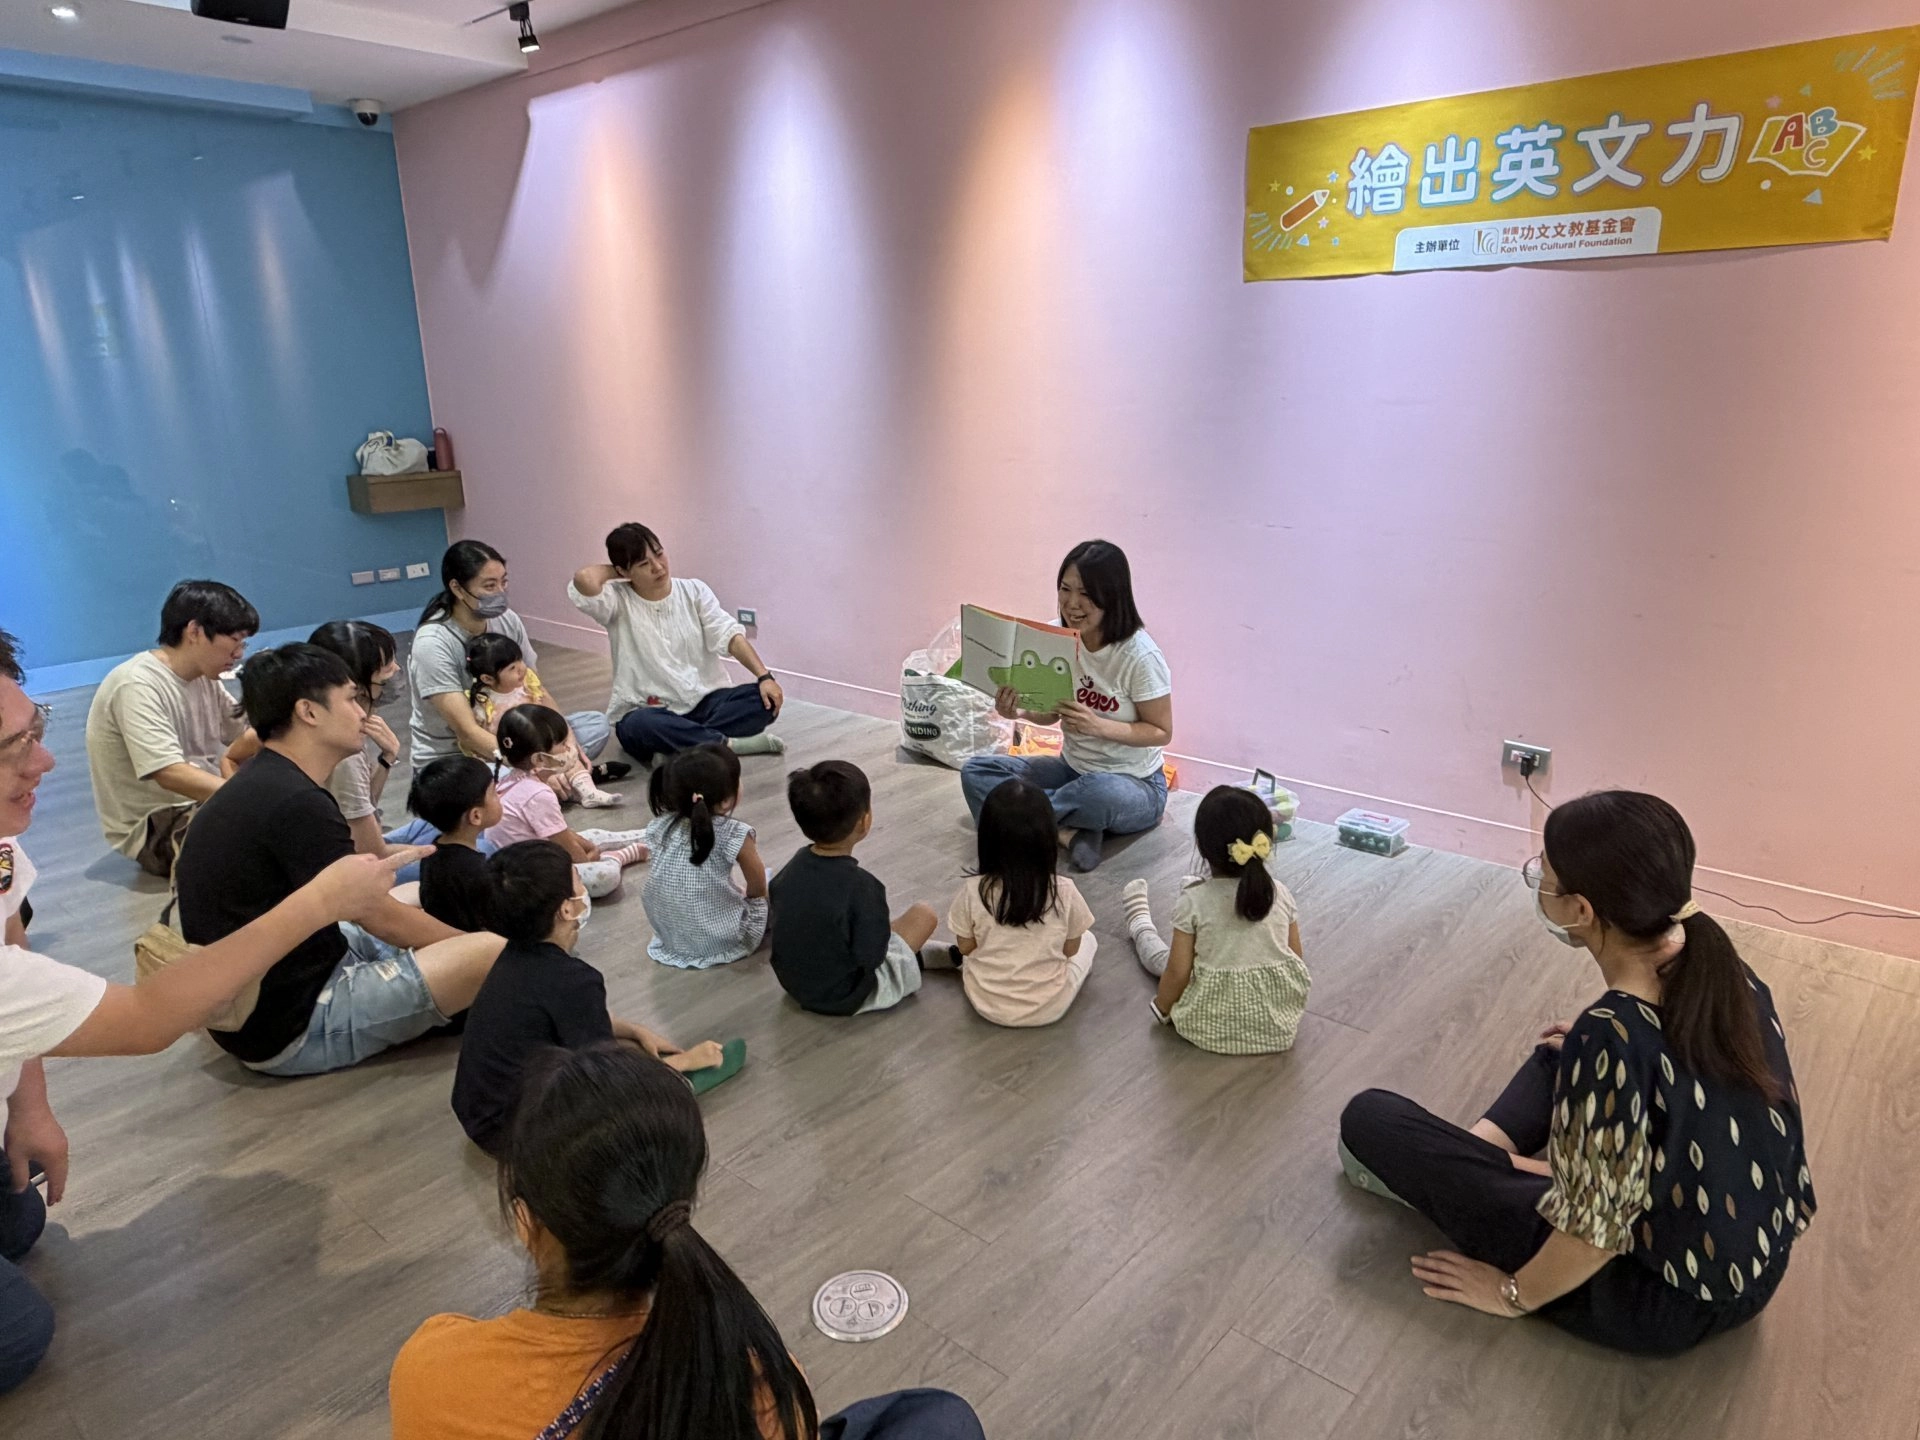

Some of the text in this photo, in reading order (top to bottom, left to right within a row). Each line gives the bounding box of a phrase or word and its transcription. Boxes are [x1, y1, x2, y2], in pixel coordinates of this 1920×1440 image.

[1345, 102, 1742, 217] 繪出英文力
[1520, 216, 1636, 240] 功文文教基金會
[1414, 238, 1460, 254] 主辦單位
[1500, 237, 1633, 254] Kon Wen Cultural Foundation
